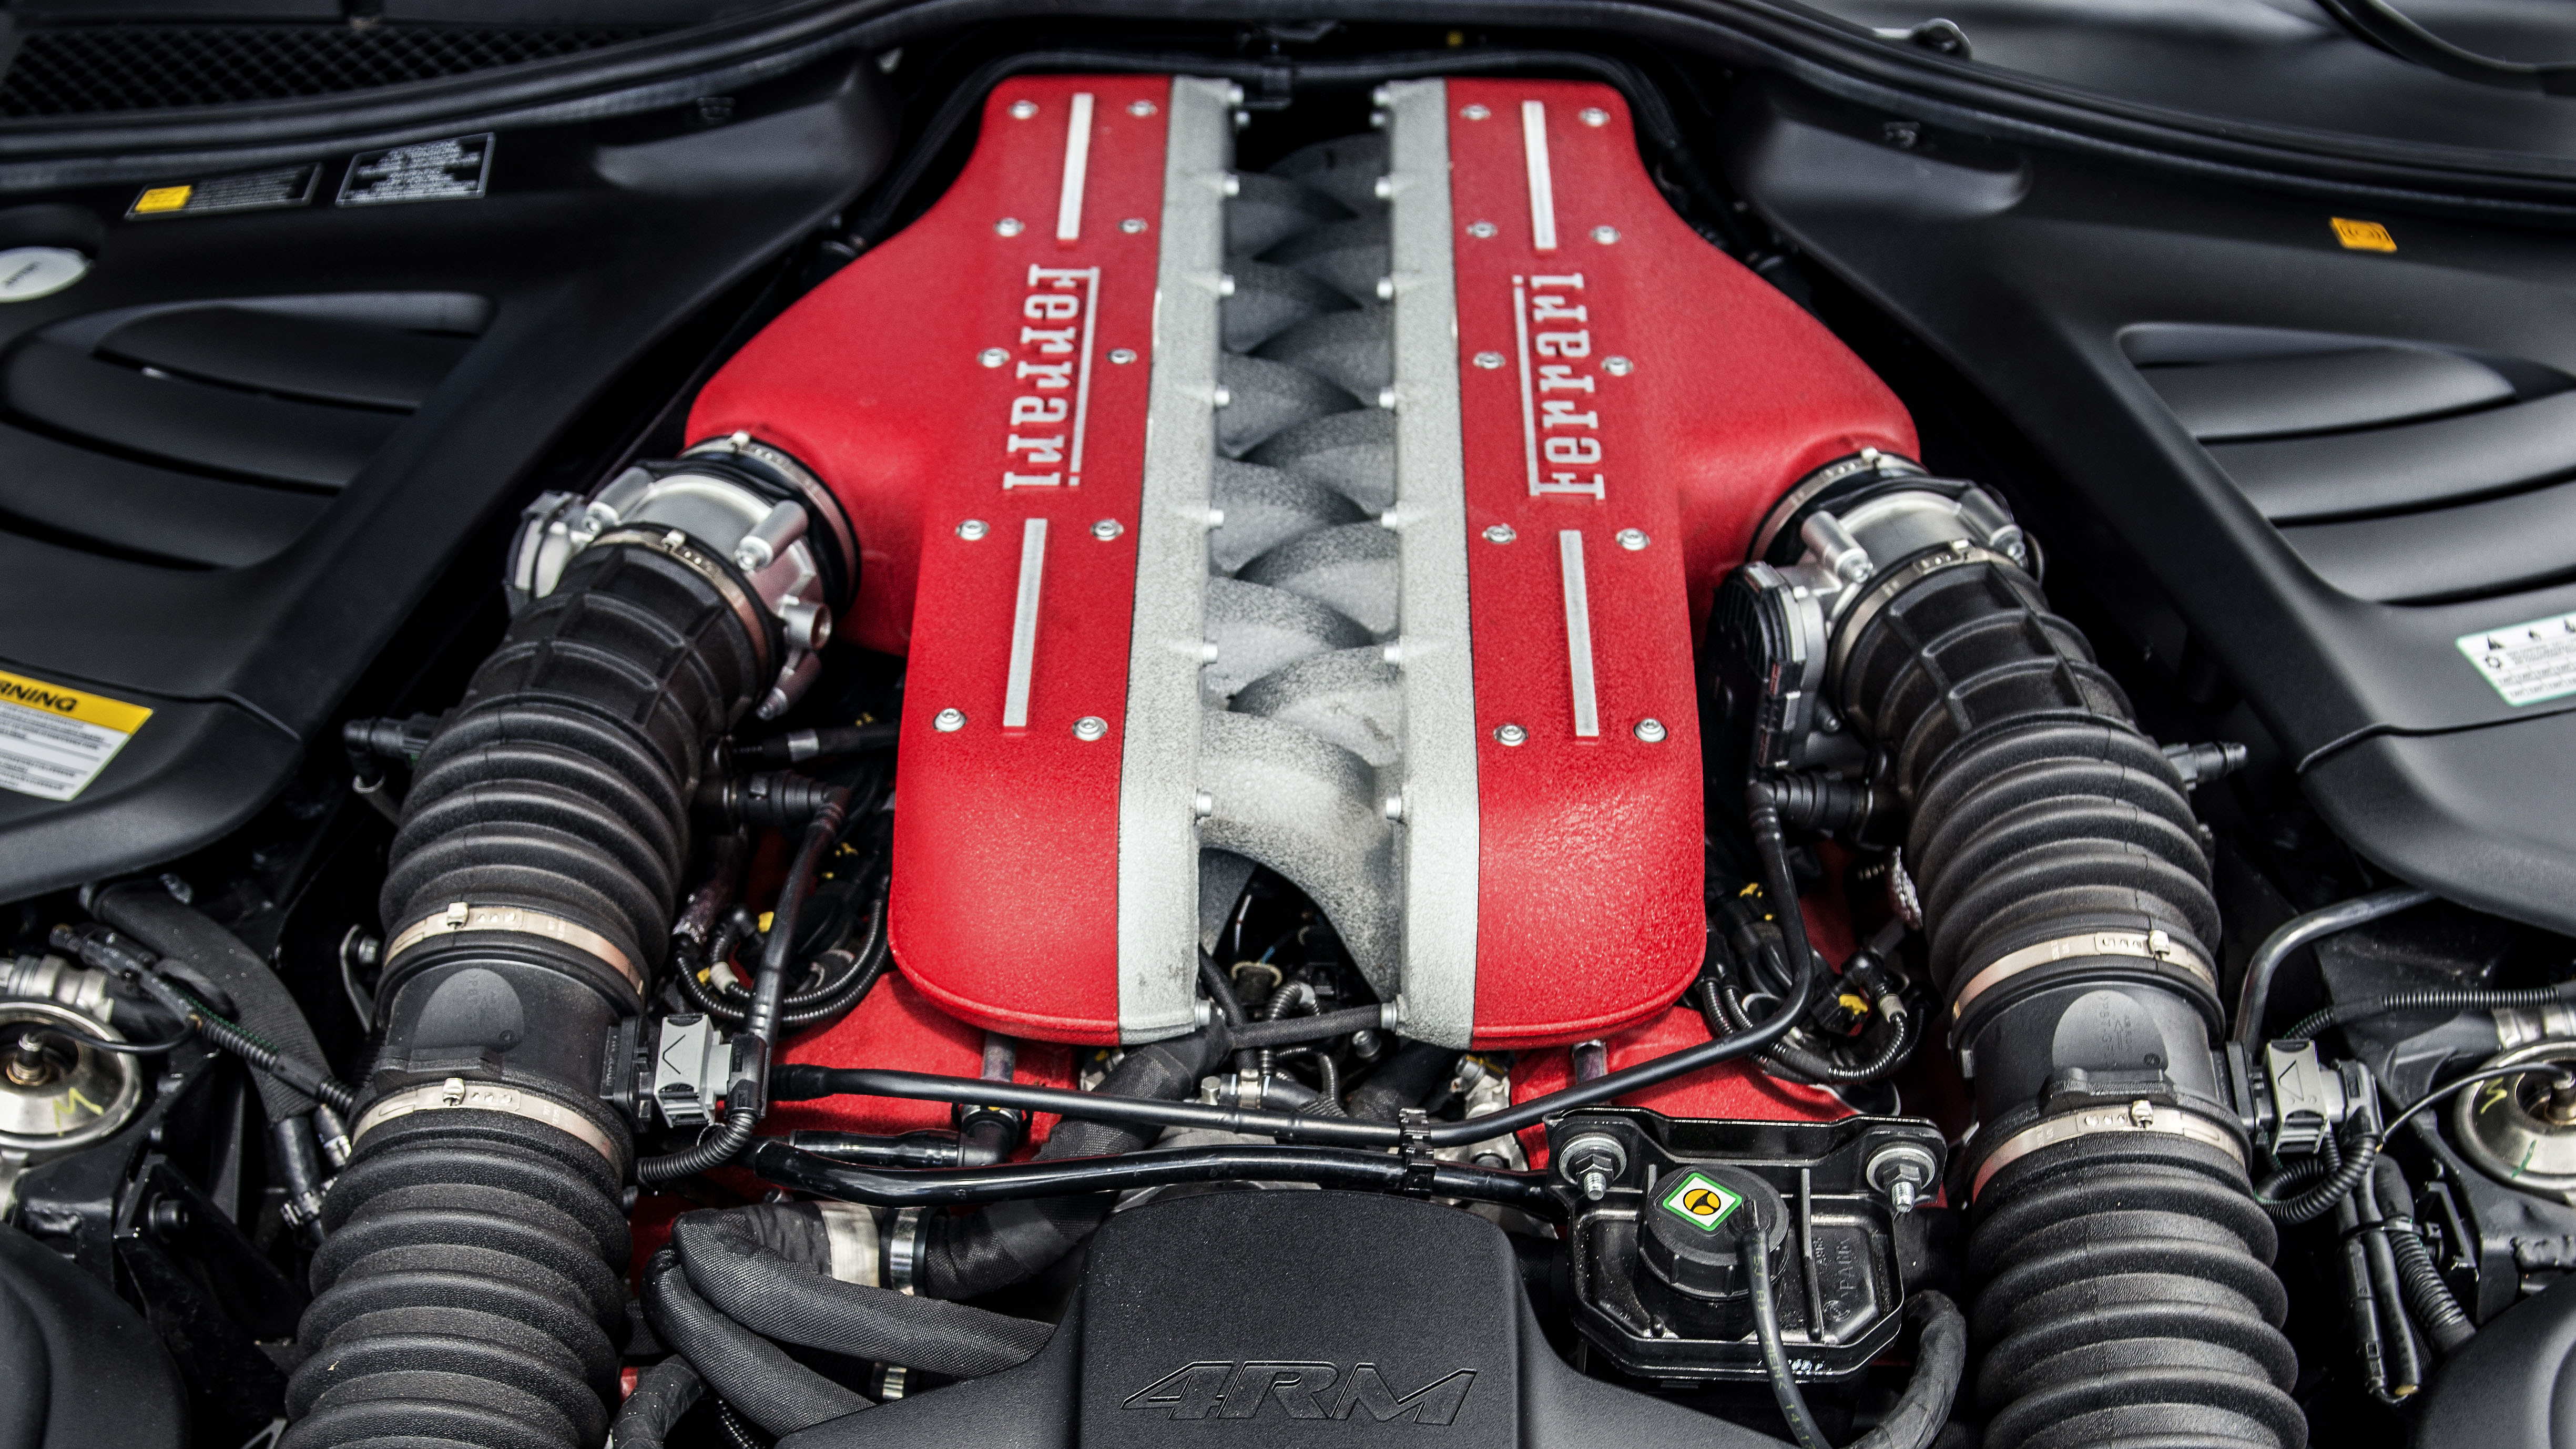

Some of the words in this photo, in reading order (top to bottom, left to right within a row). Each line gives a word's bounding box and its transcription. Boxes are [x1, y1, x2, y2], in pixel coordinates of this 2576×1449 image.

[1002, 263, 1101, 490] Ferrari
[1512, 272, 1606, 500] Ferrari
[1121, 1361, 1477, 1426] 4RM
